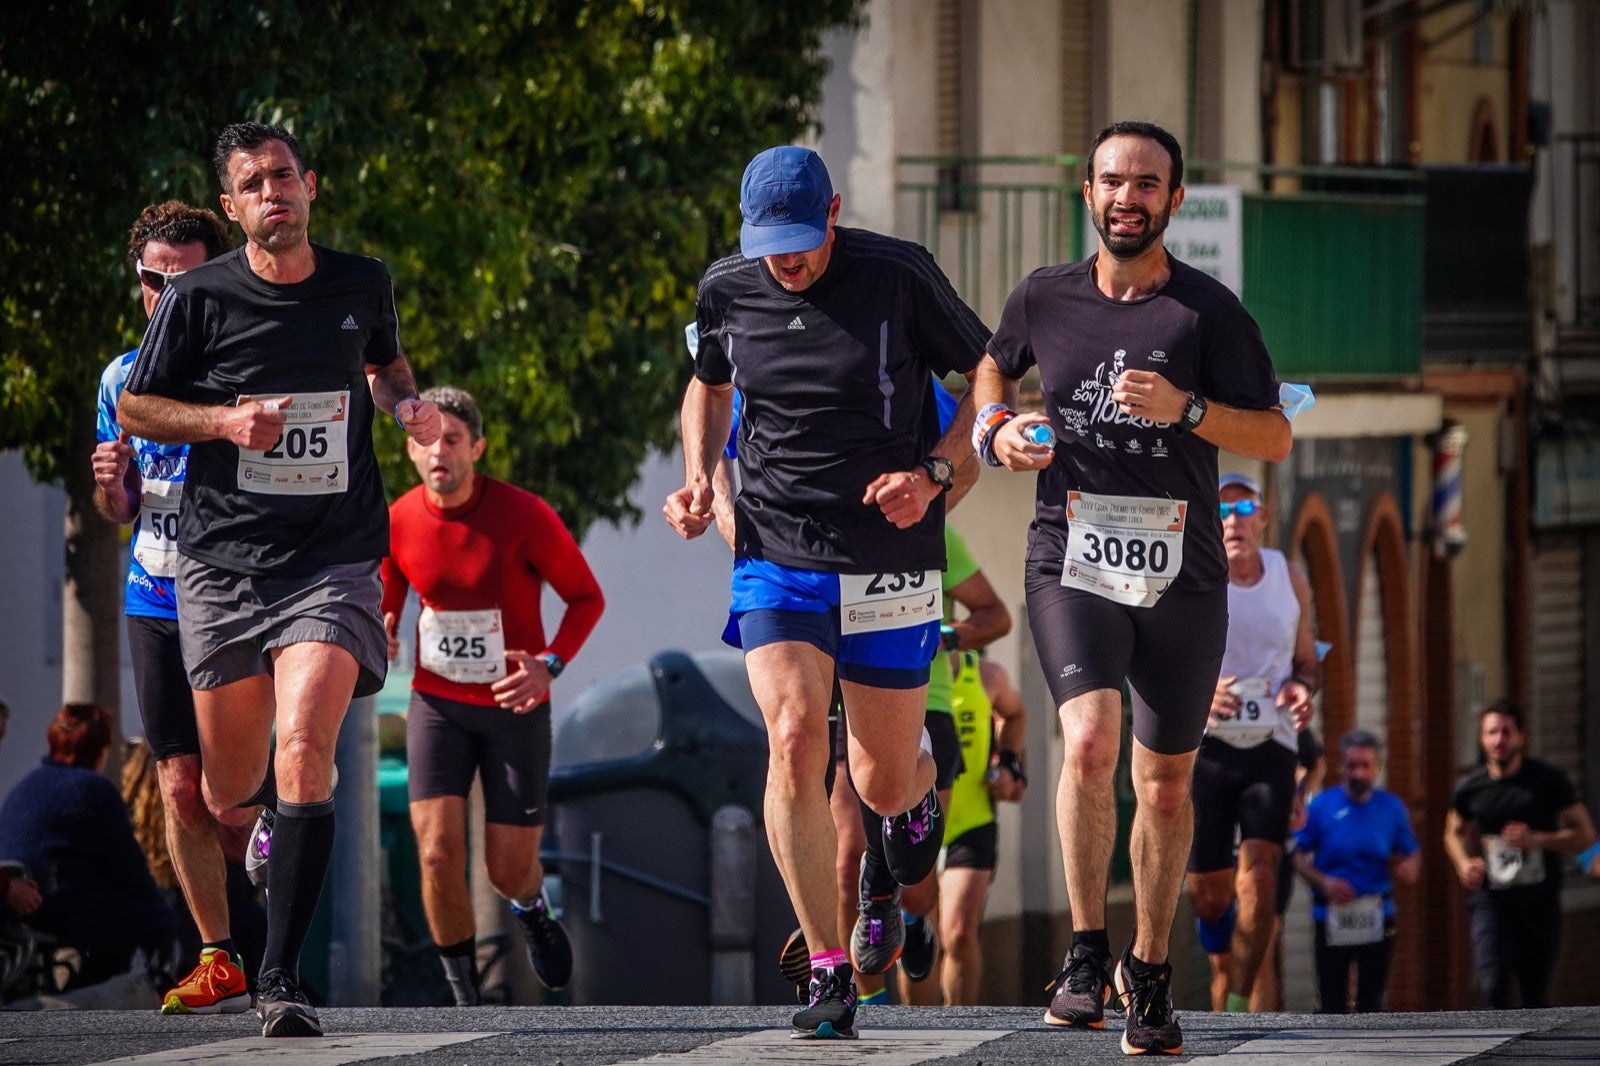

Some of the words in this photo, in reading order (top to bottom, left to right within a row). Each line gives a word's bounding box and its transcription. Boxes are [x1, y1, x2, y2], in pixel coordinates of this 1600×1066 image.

[1072, 389, 1098, 406] SOY
[263, 426, 328, 459] 205
[1083, 533, 1169, 573] 3080
[865, 569, 926, 596] 239
[438, 636, 487, 659] 425
